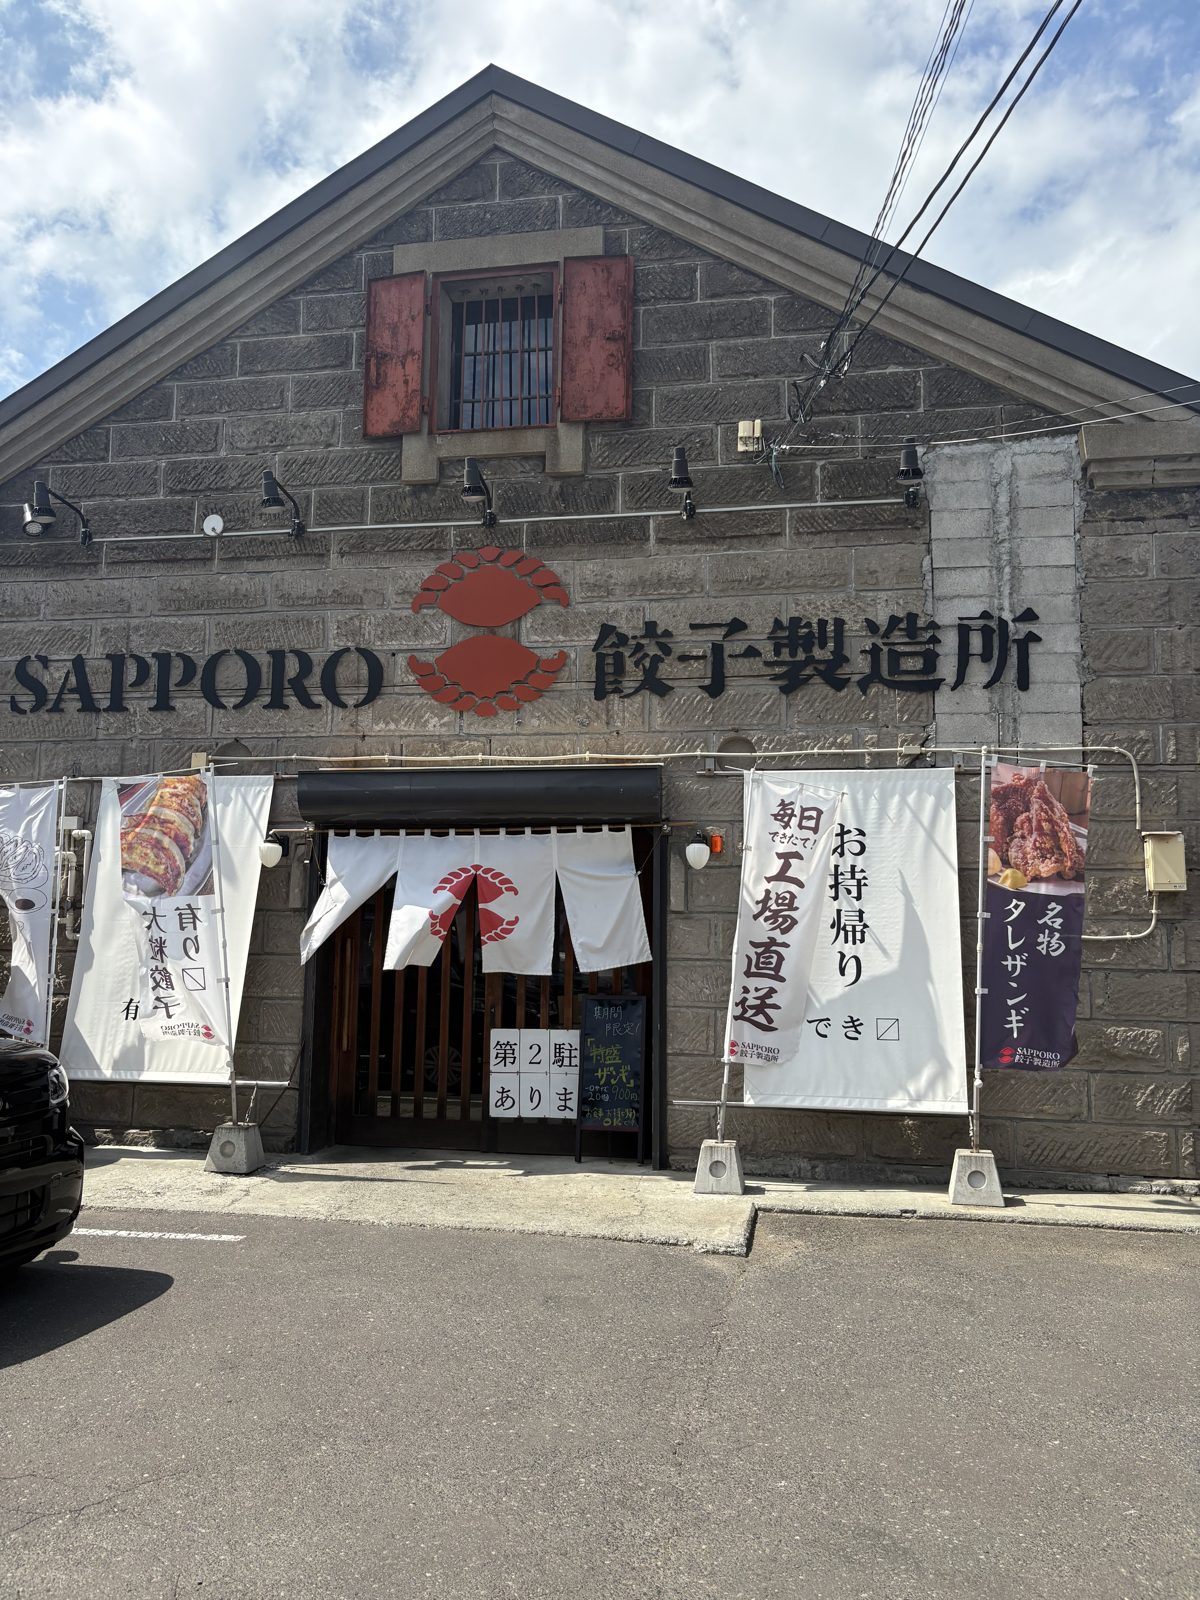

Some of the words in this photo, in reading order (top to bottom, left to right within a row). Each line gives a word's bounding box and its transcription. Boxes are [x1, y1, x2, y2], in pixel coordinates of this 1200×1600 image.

[9, 646, 384, 714] SAPPORO
[594, 607, 1042, 701] 餃子製造所
[770, 798, 825, 835] 毎日
[828, 822, 869, 988] お持帰り
[1036, 900, 1066, 958] 名物
[733, 851, 806, 1033] 工場直送
[1001, 898, 1029, 1040] タレザンギ
[741, 1041, 780, 1055] SAPPORO
[1016, 1047, 1060, 1060] SAPPORO
